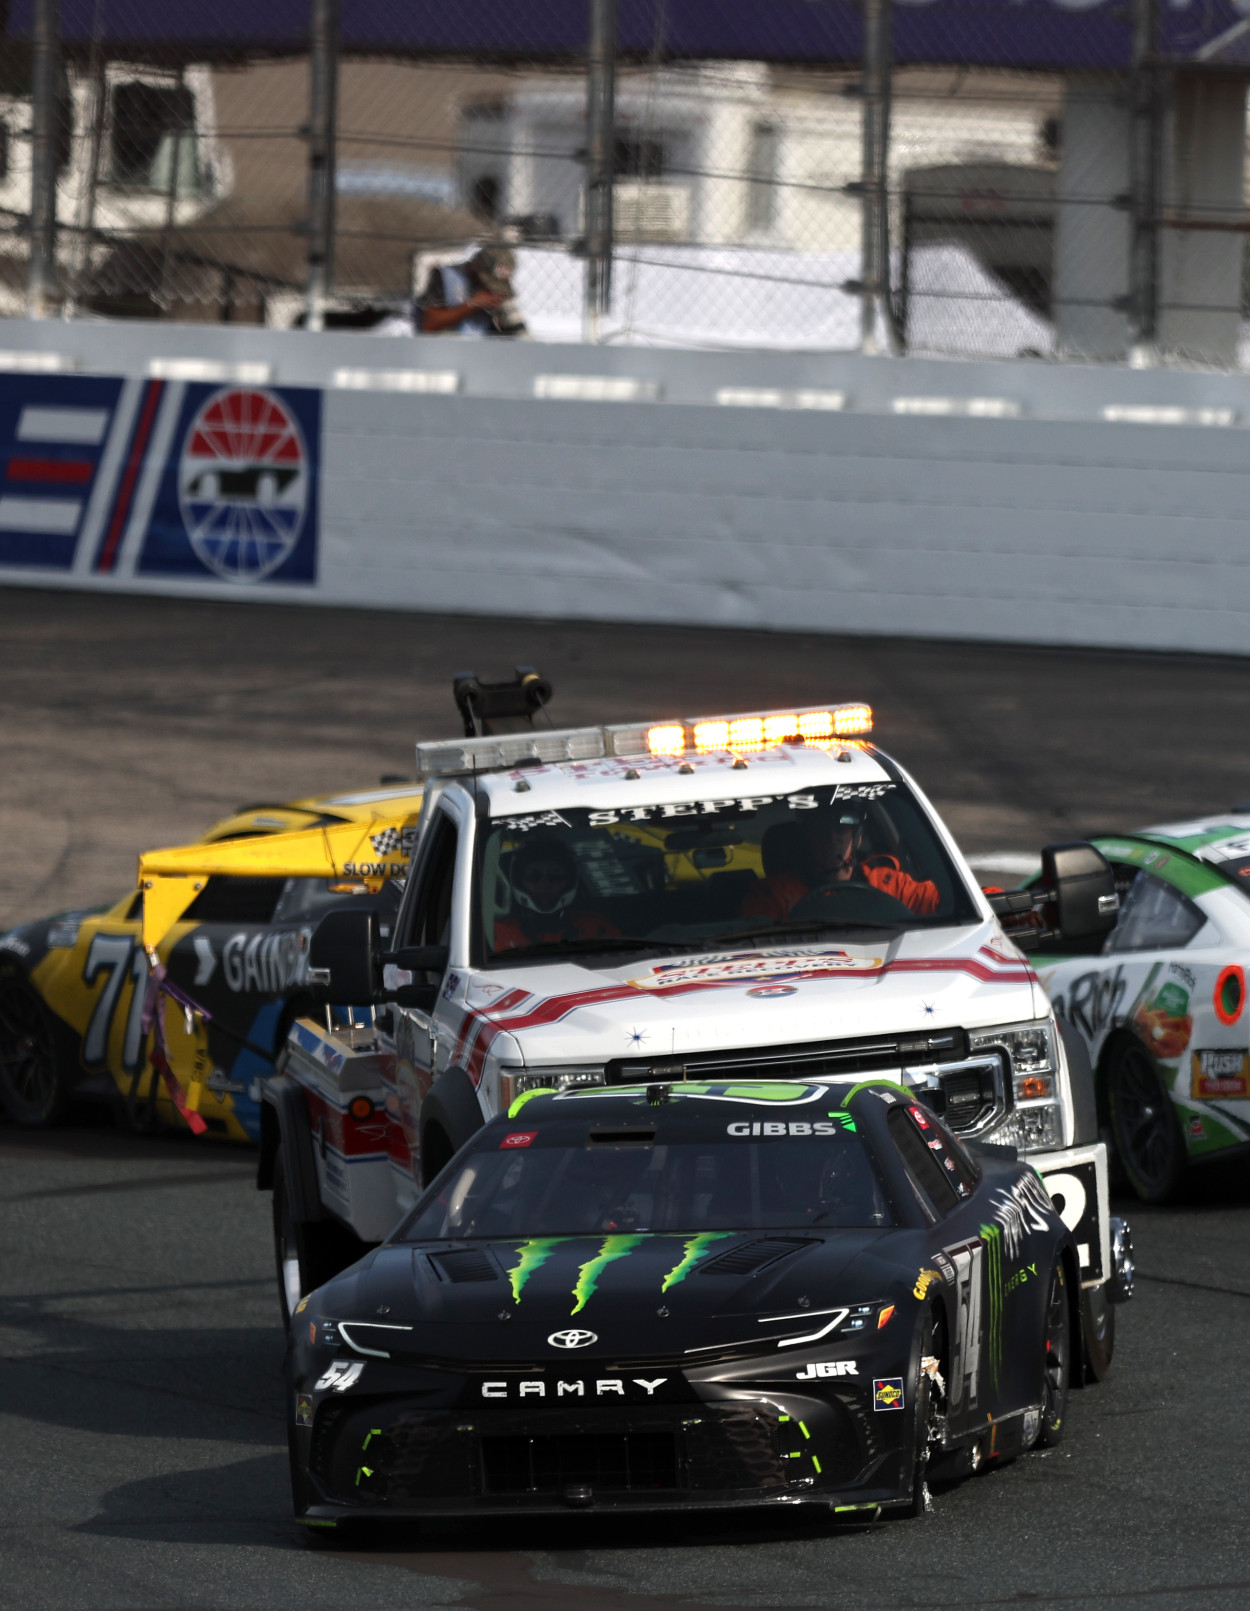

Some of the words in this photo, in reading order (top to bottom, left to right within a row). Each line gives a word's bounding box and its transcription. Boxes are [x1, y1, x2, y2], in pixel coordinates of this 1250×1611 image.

[588, 794, 818, 827] STEPP'S
[343, 861, 386, 876] SLOW
[83, 931, 148, 1071] 71
[727, 1122, 836, 1136] GIBBS
[314, 1361, 365, 1392] 54
[796, 1361, 859, 1379] JGR
[482, 1378, 668, 1397] CAMRY
[877, 1389, 901, 1400] SUNOCO
